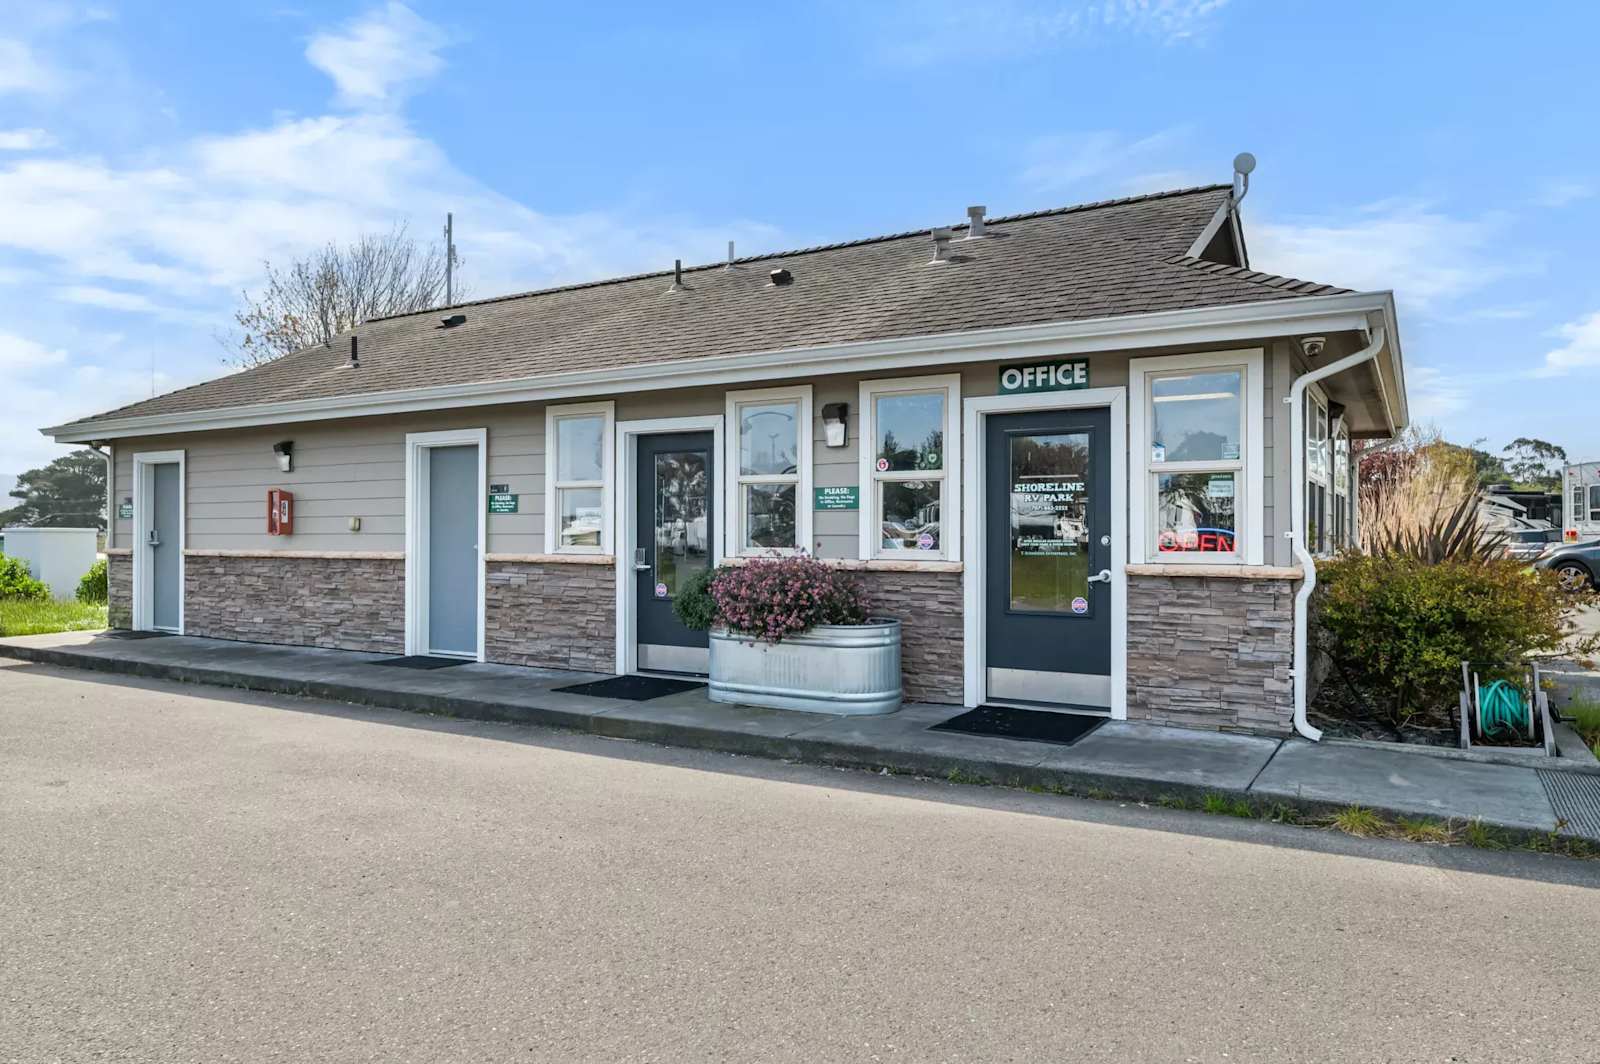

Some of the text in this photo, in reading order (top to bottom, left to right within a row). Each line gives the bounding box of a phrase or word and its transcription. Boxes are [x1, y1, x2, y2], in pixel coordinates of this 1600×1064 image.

[1002, 362, 1087, 390] OFFICE
[1014, 482, 1085, 492] SHORELINE
[1024, 493, 1074, 502] RV PARK
[1159, 531, 1236, 552] OPEN
